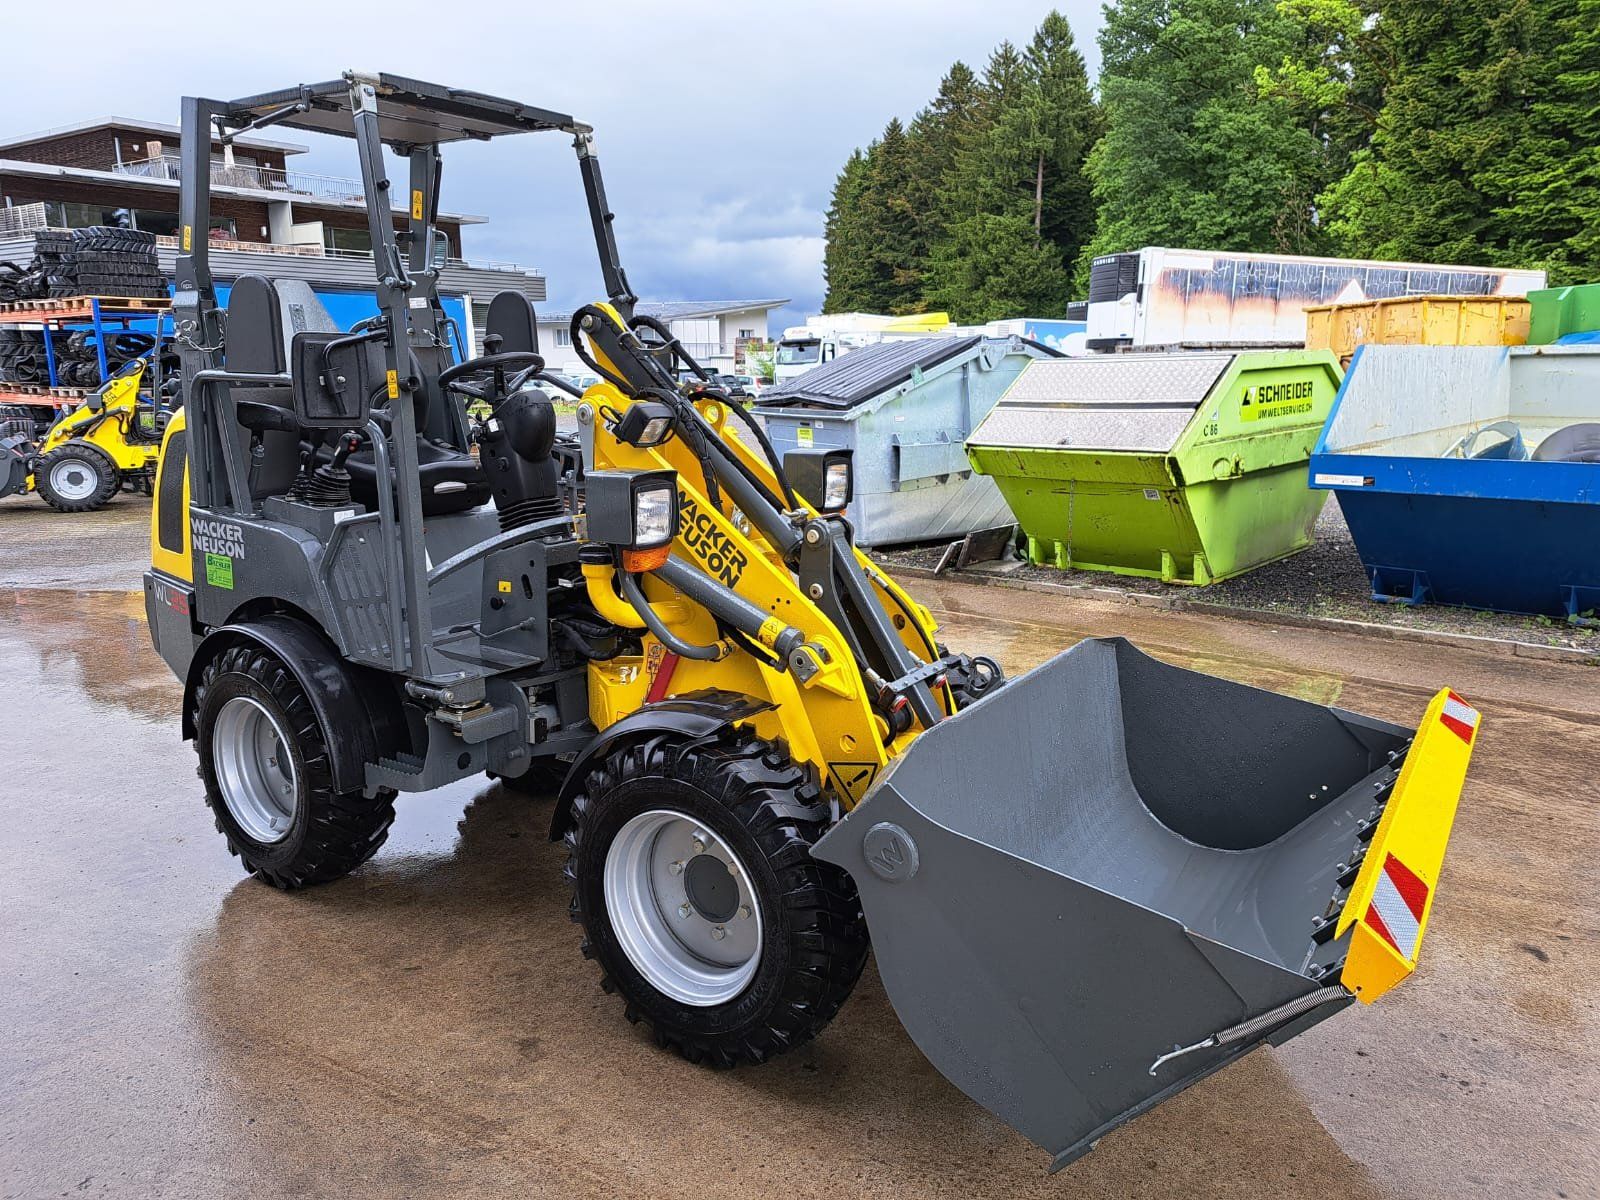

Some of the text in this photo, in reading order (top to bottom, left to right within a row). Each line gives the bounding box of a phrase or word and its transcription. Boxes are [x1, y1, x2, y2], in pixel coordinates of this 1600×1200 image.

[1258, 381, 1313, 404] SCHNEIDER
[1257, 403, 1313, 419] UMWELTSERVICE.CH
[1203, 424, 1218, 437] C 86
[190, 517, 244, 543] WACKER
[192, 534, 245, 559] NEUSON
